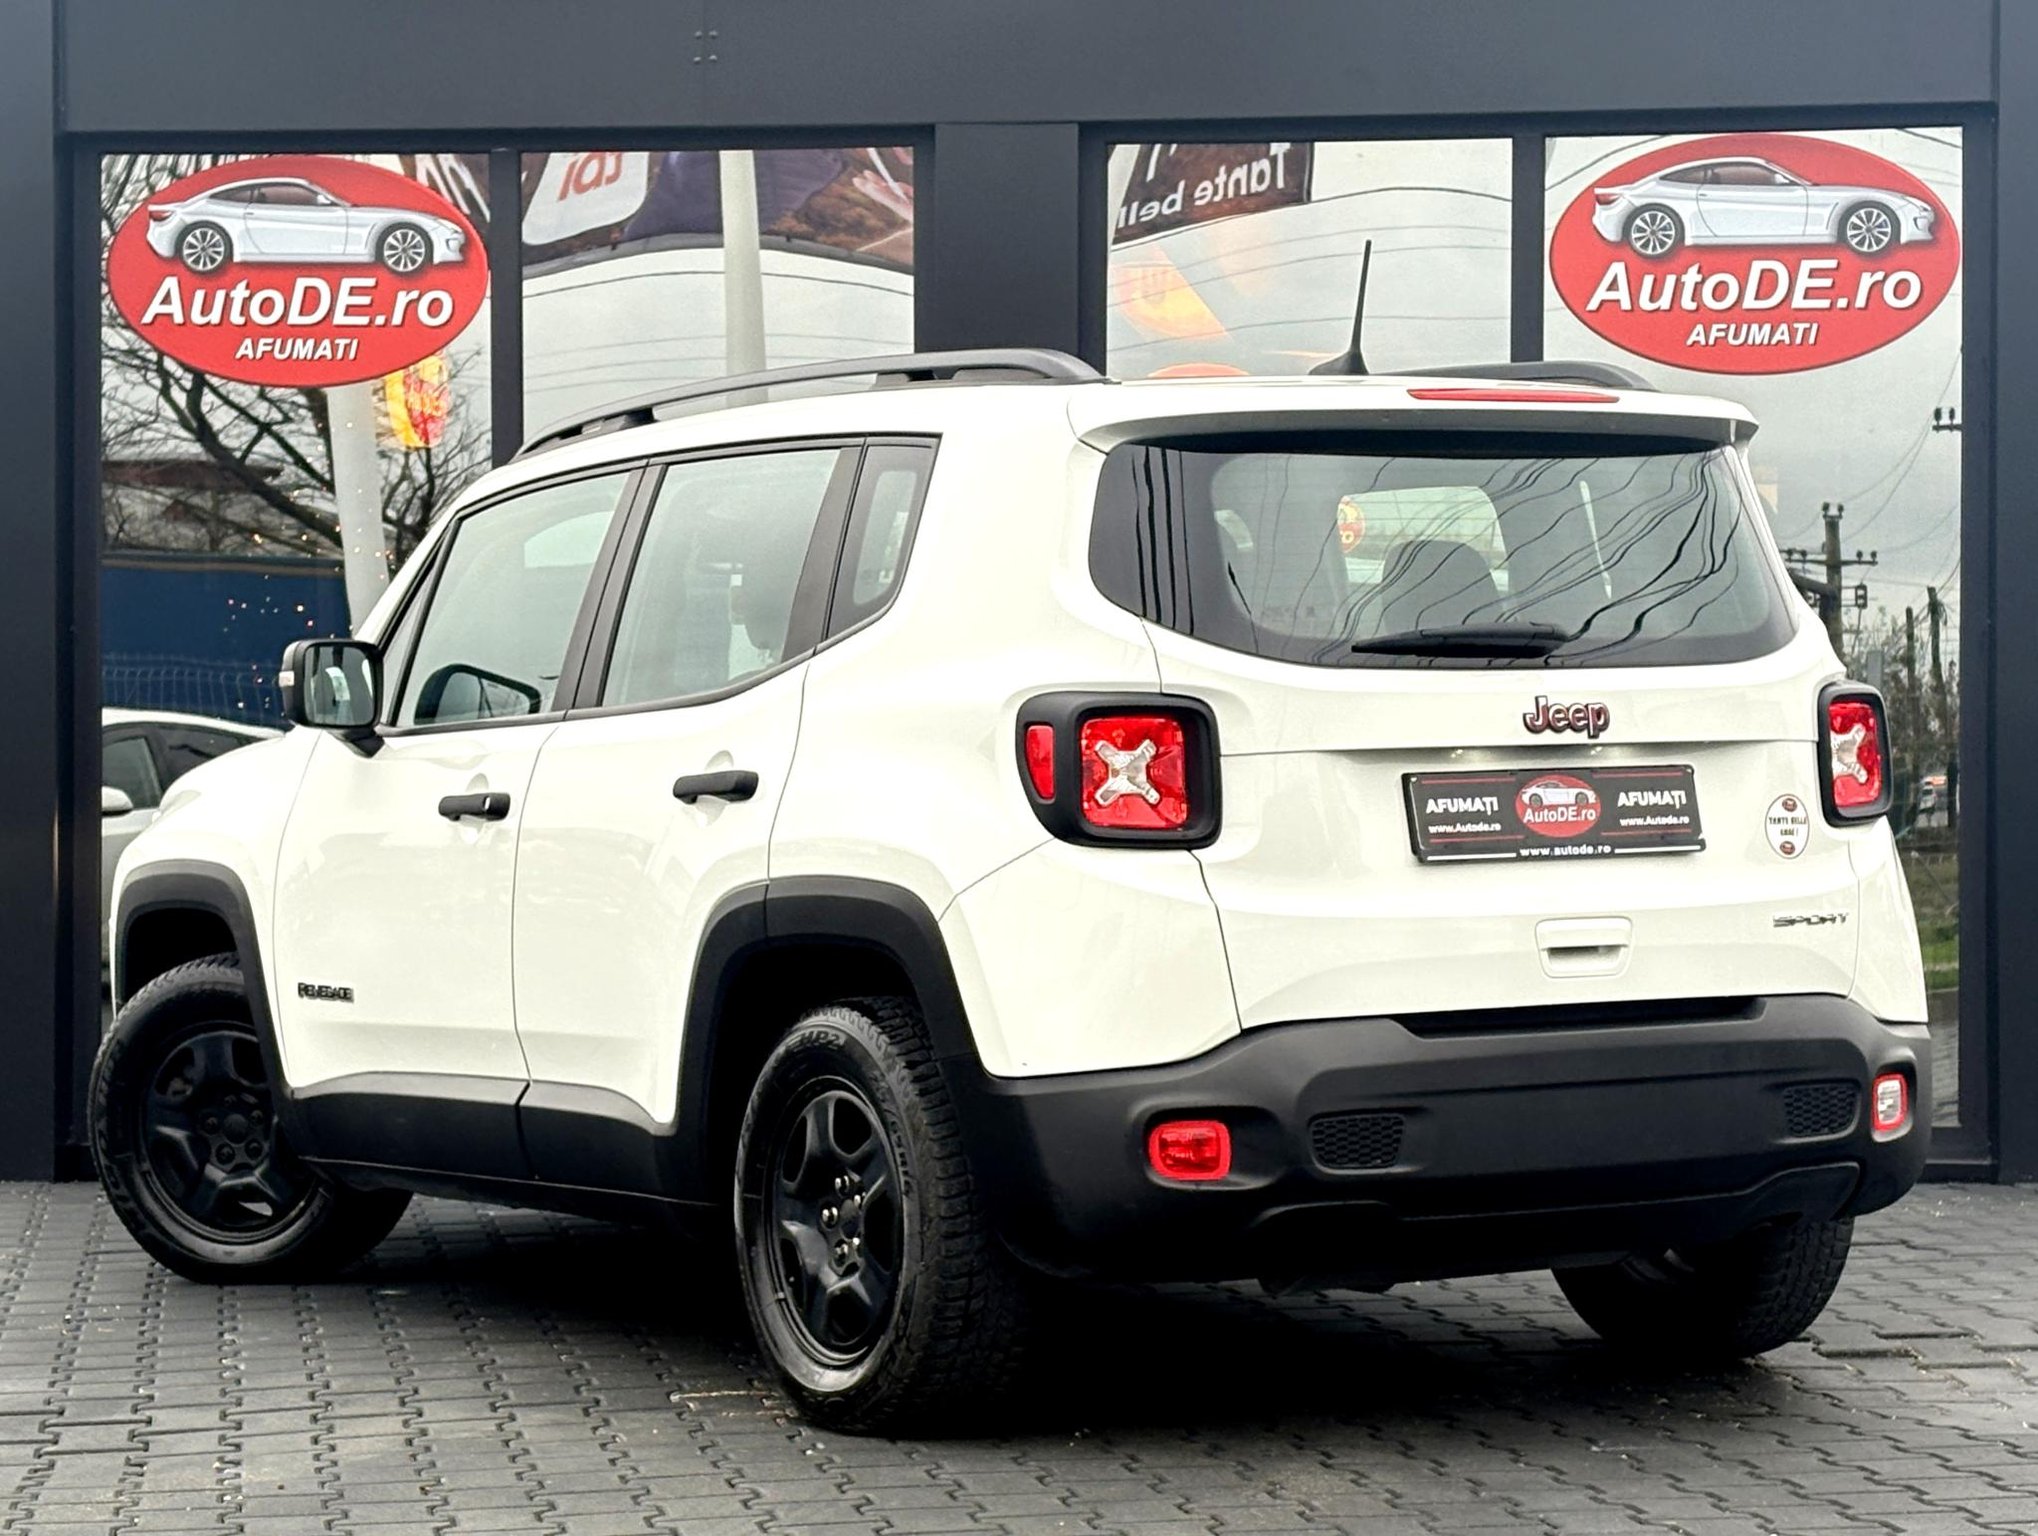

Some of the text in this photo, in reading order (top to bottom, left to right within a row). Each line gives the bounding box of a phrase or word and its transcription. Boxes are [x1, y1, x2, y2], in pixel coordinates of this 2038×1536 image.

[1586, 258, 1921, 312] AutoDE.ro
[141, 276, 454, 327] AutoDE.ro
[1686, 323, 1818, 346] AFUMATI
[235, 338, 358, 361] AFUMATI
[1523, 695, 1610, 739] Jeep
[1522, 805, 1597, 825] AutoDE.ro
[1519, 843, 1612, 858] www.autode.ro
